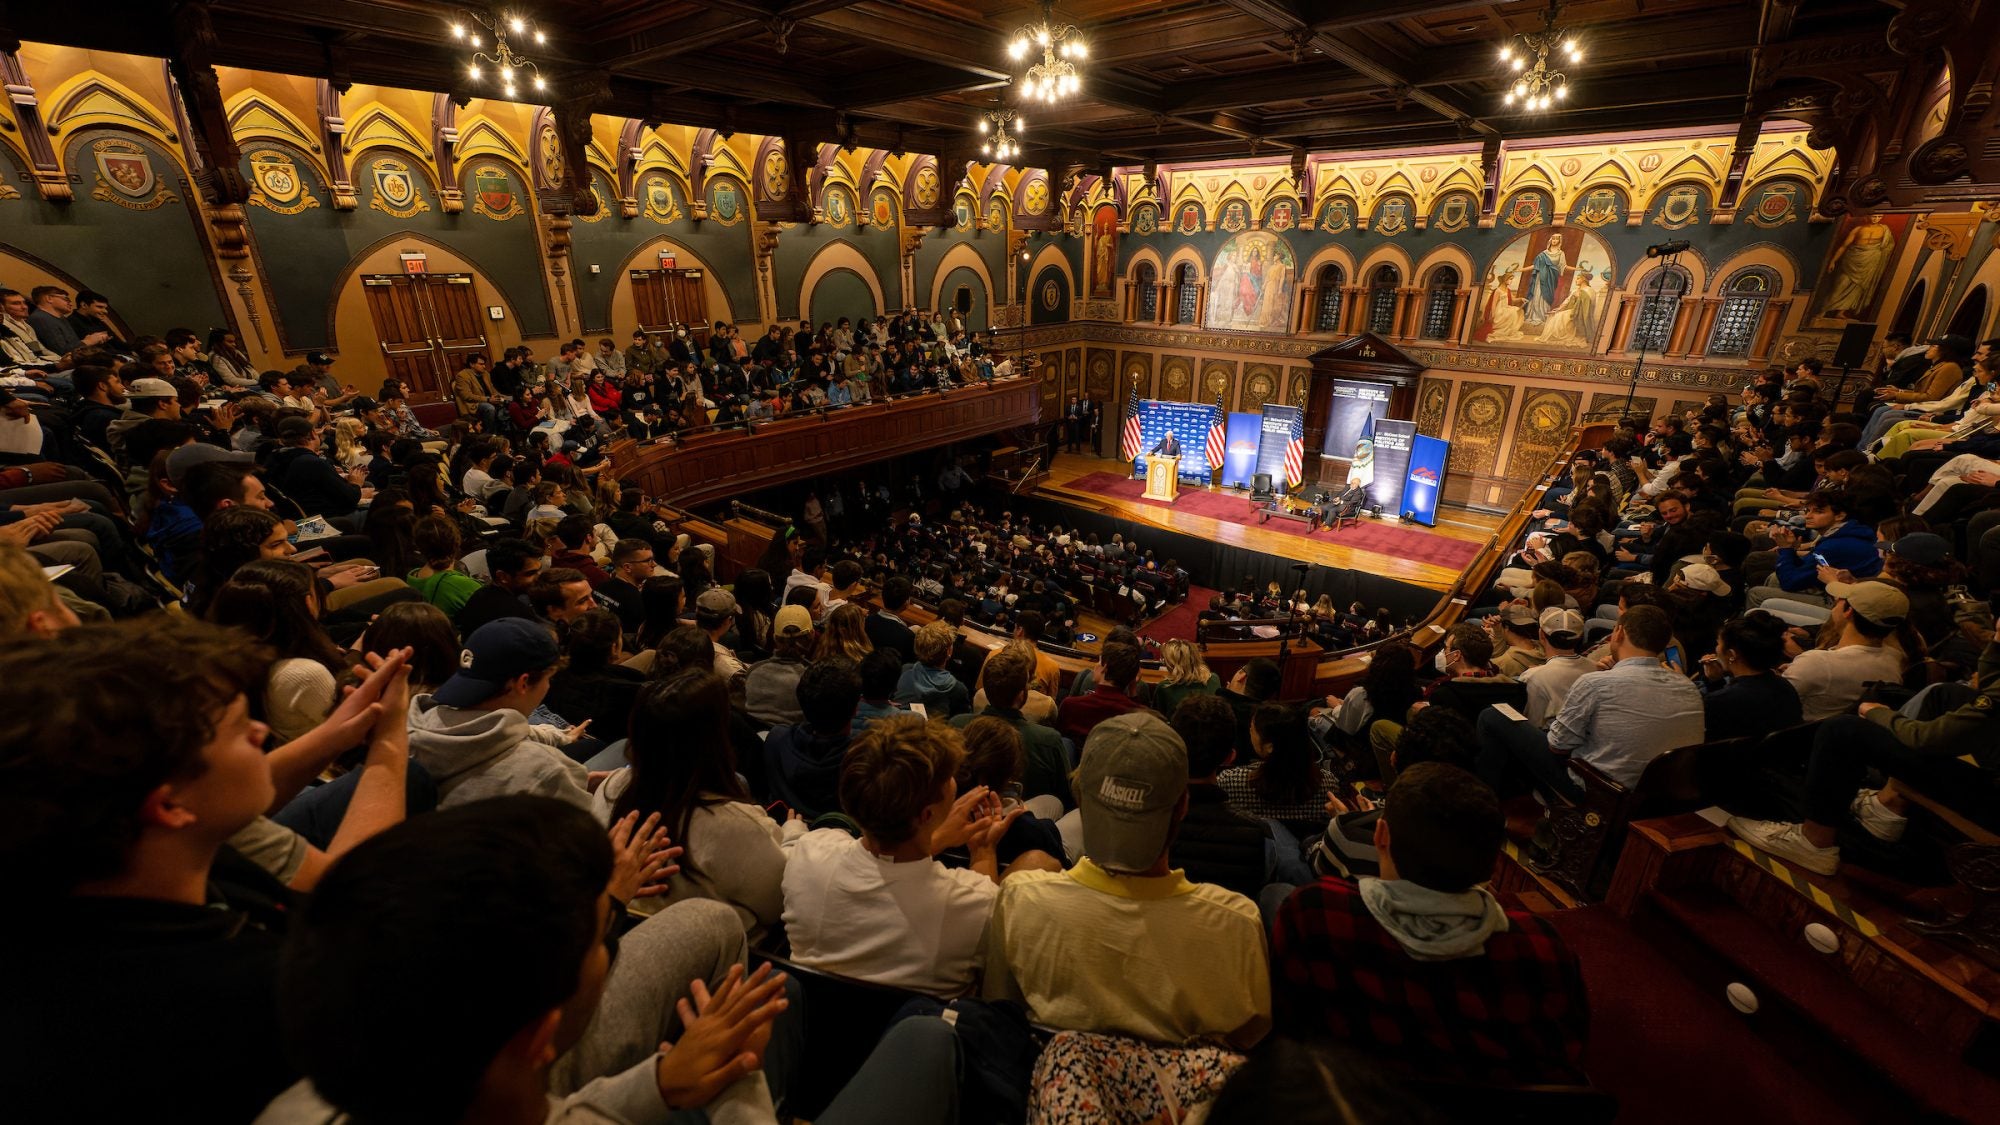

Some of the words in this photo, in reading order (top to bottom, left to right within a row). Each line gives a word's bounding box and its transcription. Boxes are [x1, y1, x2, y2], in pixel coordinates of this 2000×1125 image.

[407, 260, 425, 273] EXIT
[460, 648, 474, 669] G
[1099, 775, 1146, 804] HASKELL
